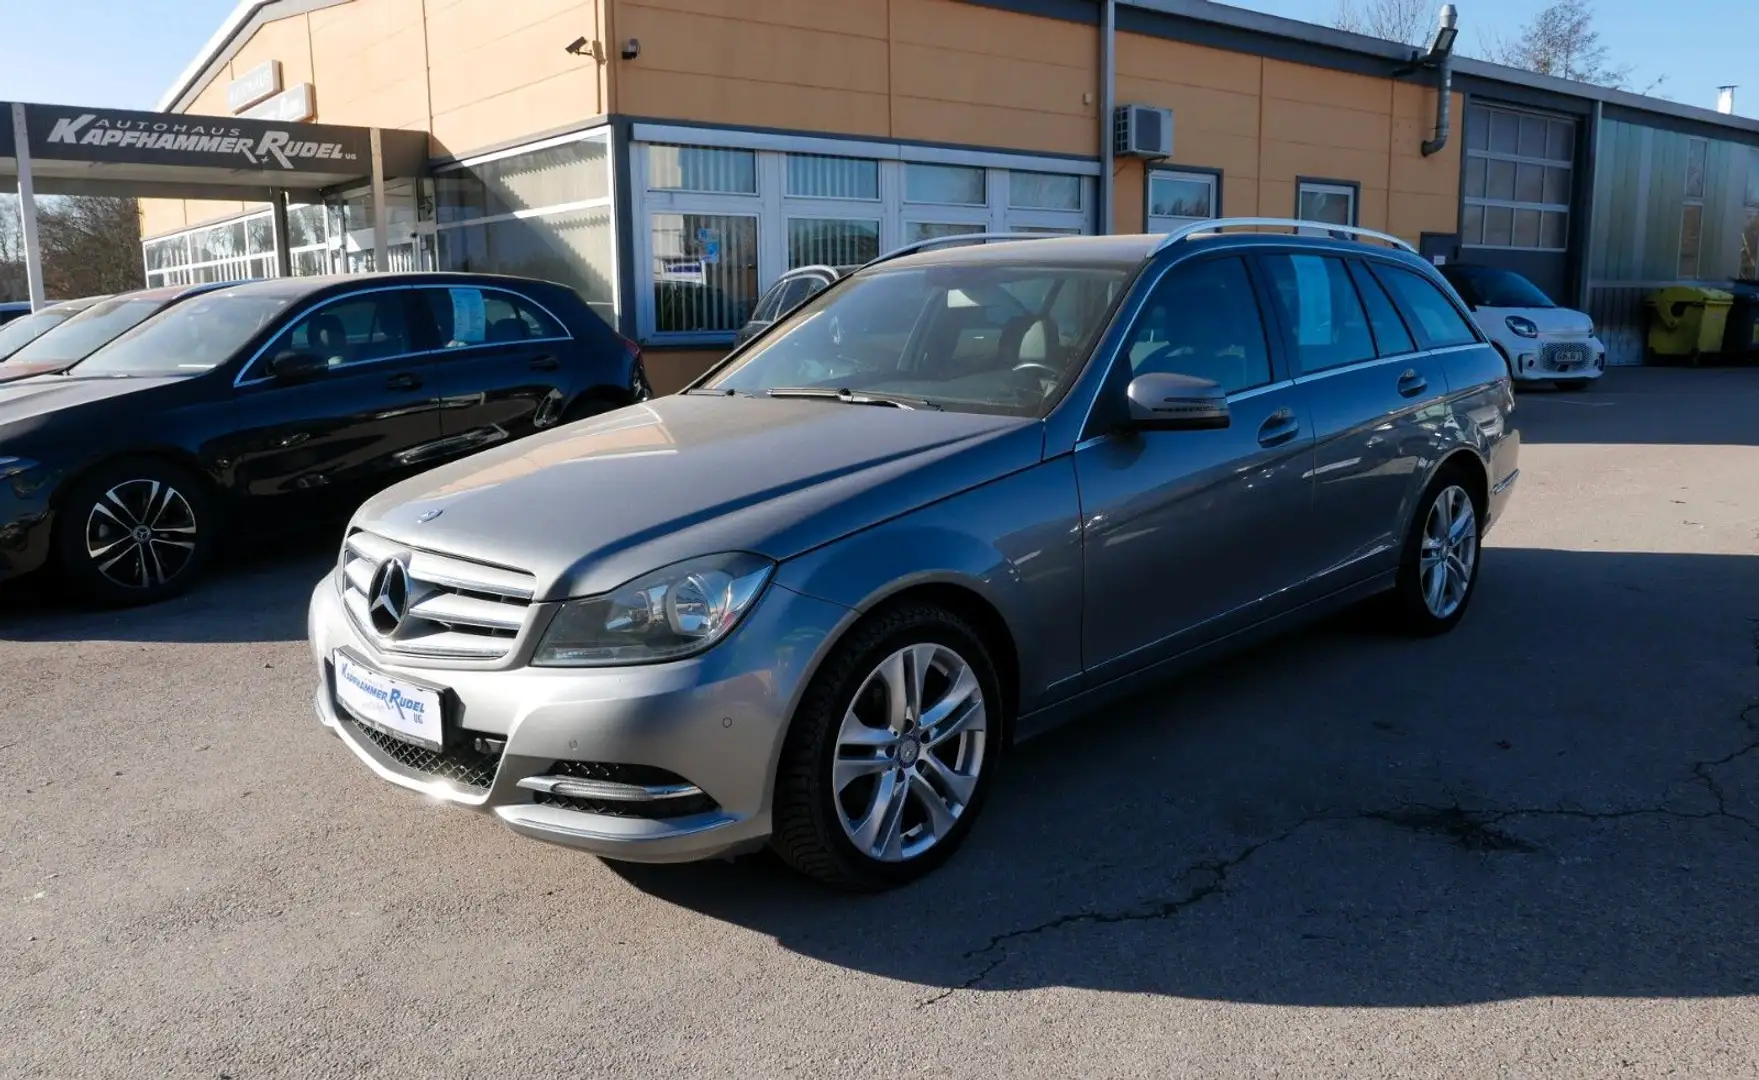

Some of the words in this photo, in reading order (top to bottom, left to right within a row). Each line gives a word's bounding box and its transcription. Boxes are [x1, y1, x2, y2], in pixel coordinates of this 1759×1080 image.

[95, 118, 241, 137] AUTOHAUS
[46, 113, 259, 164] KAPFHAMMER
[255, 130, 343, 169] RUDEL
[389, 687, 425, 720] RUDEL
[412, 712, 424, 724] UG
